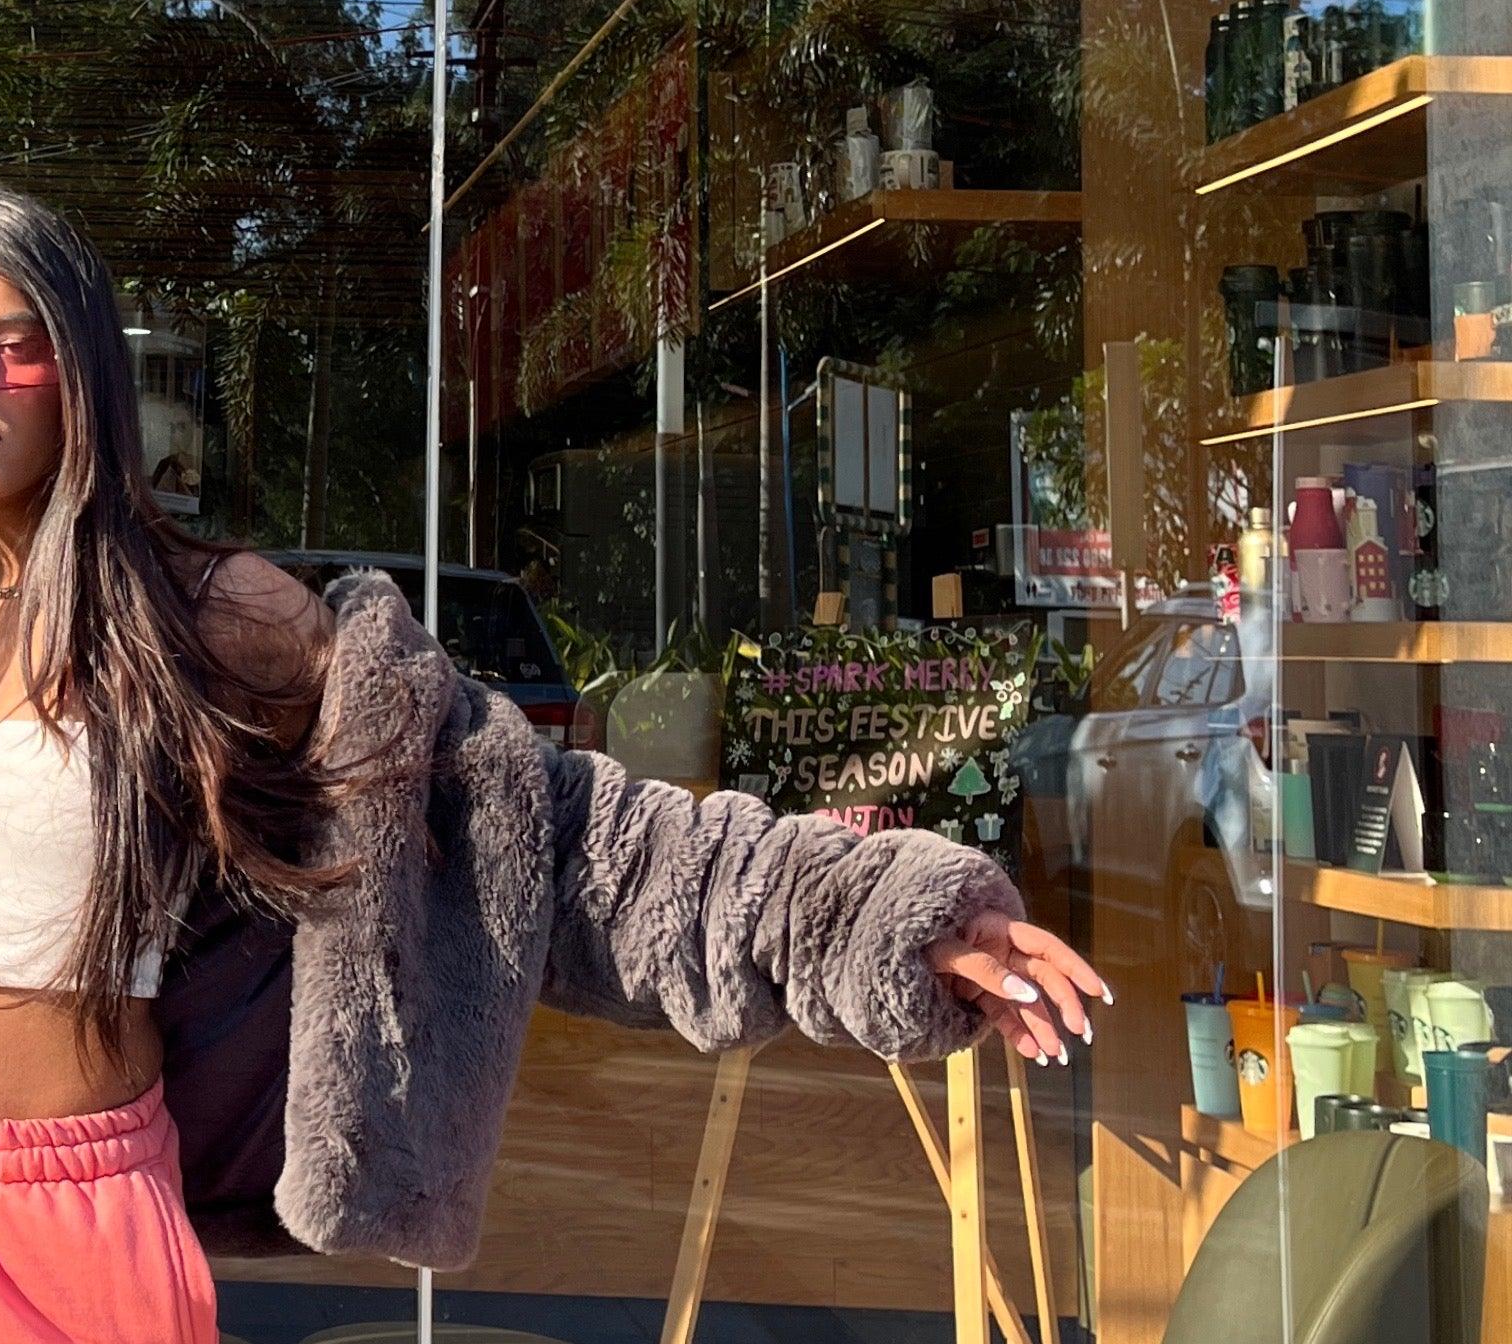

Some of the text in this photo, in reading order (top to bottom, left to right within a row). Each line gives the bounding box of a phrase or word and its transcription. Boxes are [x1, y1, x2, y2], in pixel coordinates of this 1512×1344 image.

[904, 657, 998, 692] MERRY
[744, 703, 999, 746] THIS FESTIVE
[794, 752, 934, 793] SEASON
